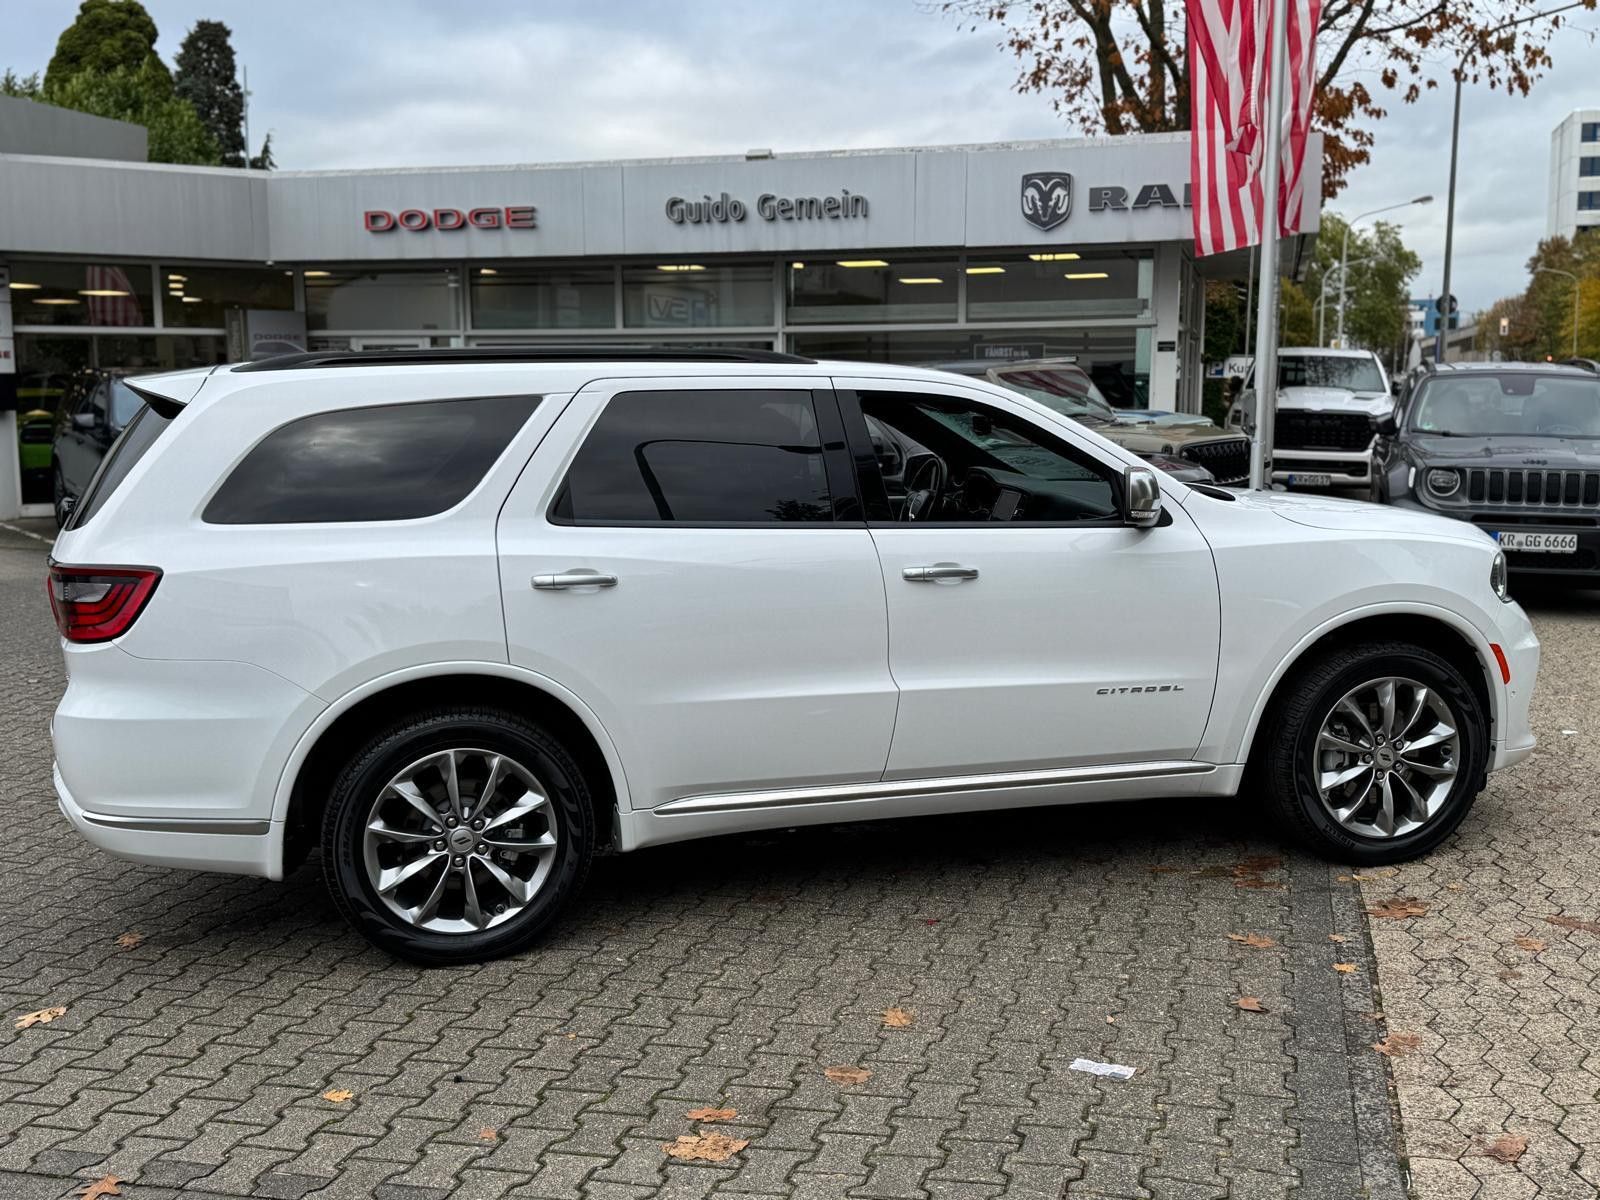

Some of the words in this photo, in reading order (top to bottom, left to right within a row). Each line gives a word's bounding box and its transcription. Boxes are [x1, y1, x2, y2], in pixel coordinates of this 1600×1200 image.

[665, 192, 747, 224] Guido
[757, 188, 869, 221] Gemein
[1088, 183, 1193, 211] RA
[364, 206, 537, 232] DODGE
[1499, 534, 1516, 546] KR
[1525, 535, 1541, 547] GG
[1544, 536, 1576, 548] 6666
[1096, 685, 1184, 695] CITADEL
